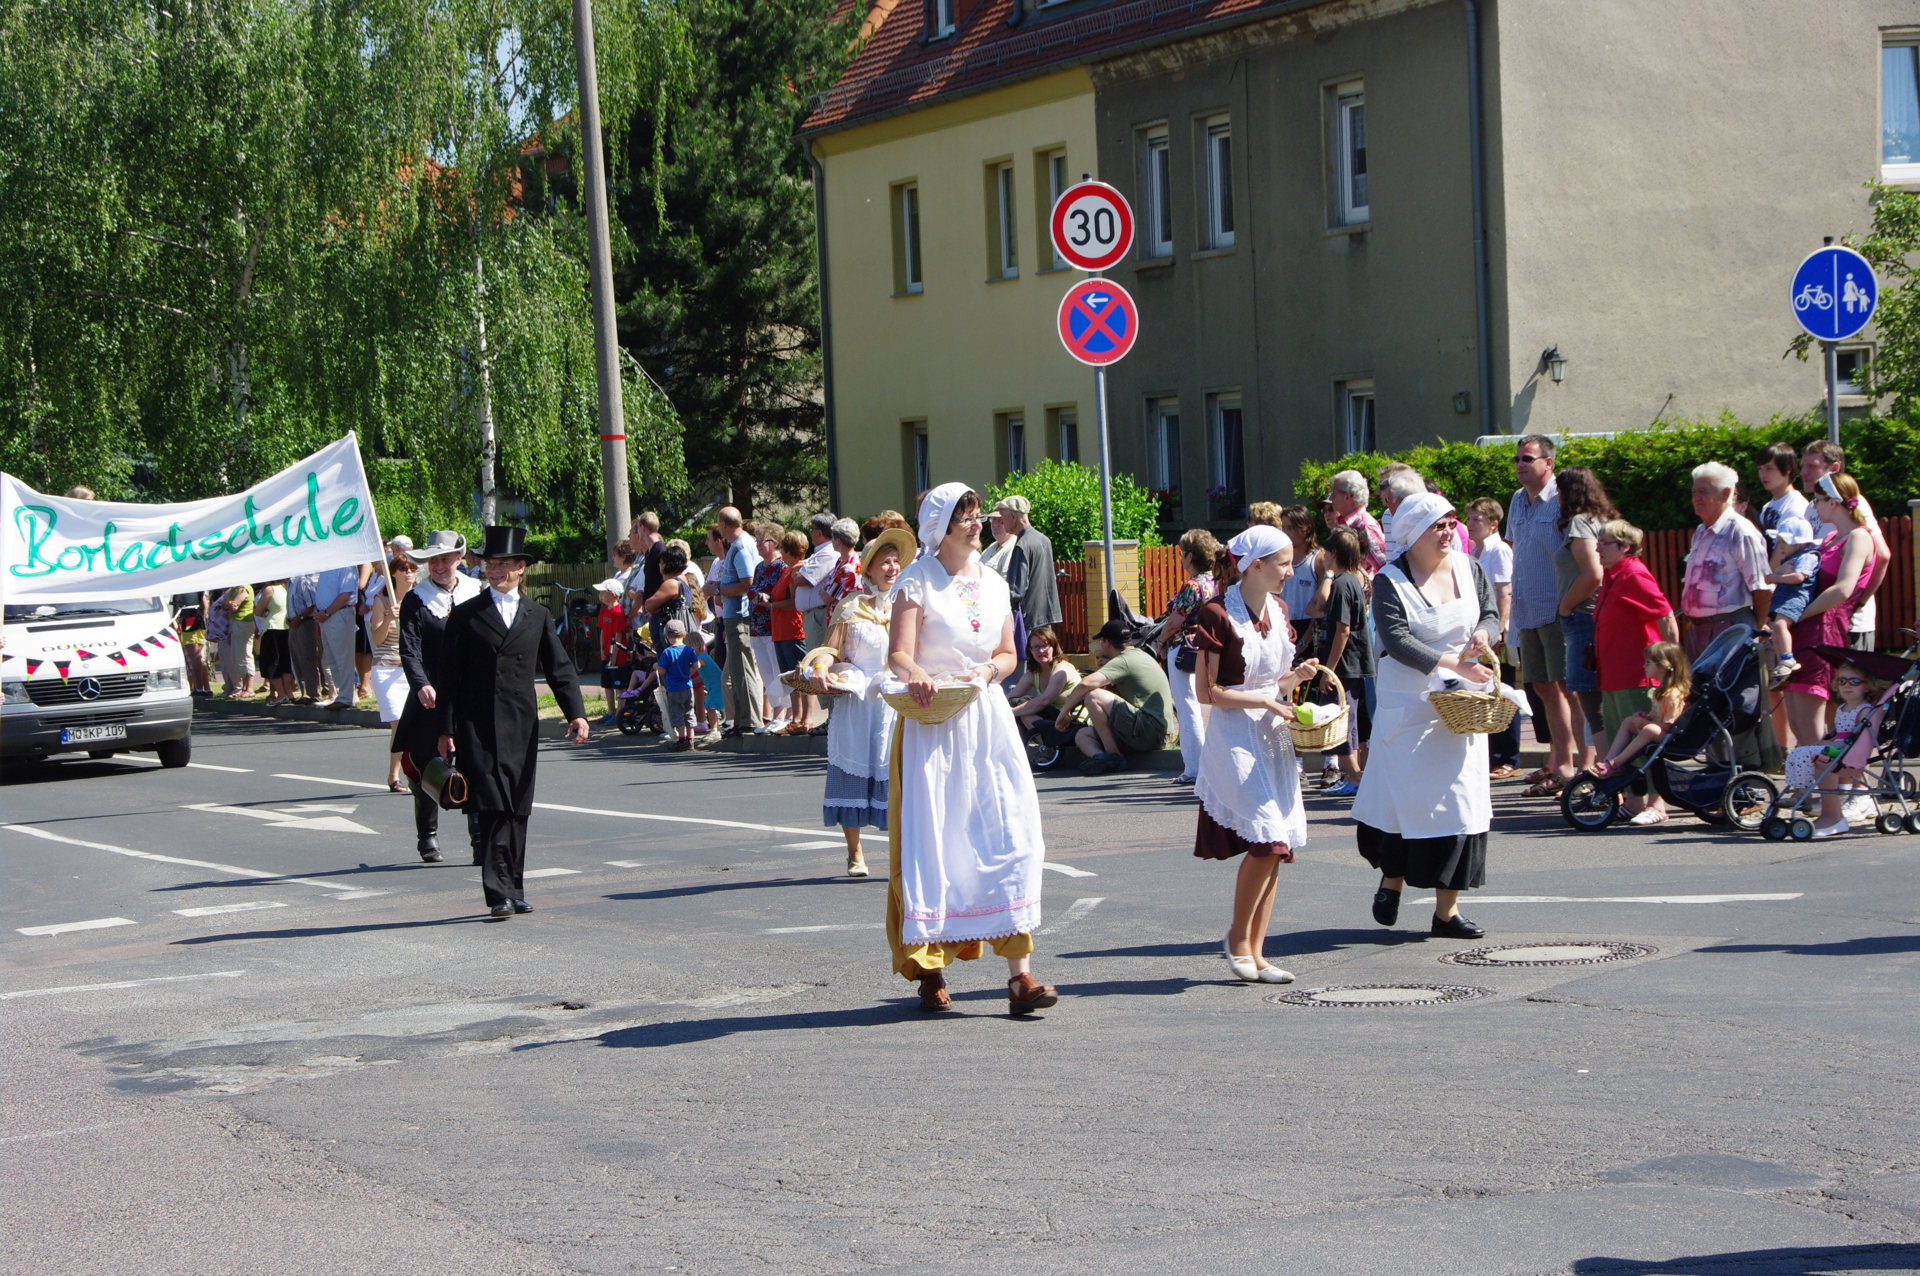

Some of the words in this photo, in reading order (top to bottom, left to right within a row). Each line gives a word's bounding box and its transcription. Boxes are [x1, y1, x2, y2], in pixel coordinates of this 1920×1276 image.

[1069, 207, 1115, 247] 30
[10, 471, 365, 578] Borlachschule
[68, 729, 82, 740] MQ
[89, 727, 103, 739] KP
[105, 725, 125, 737] 109
